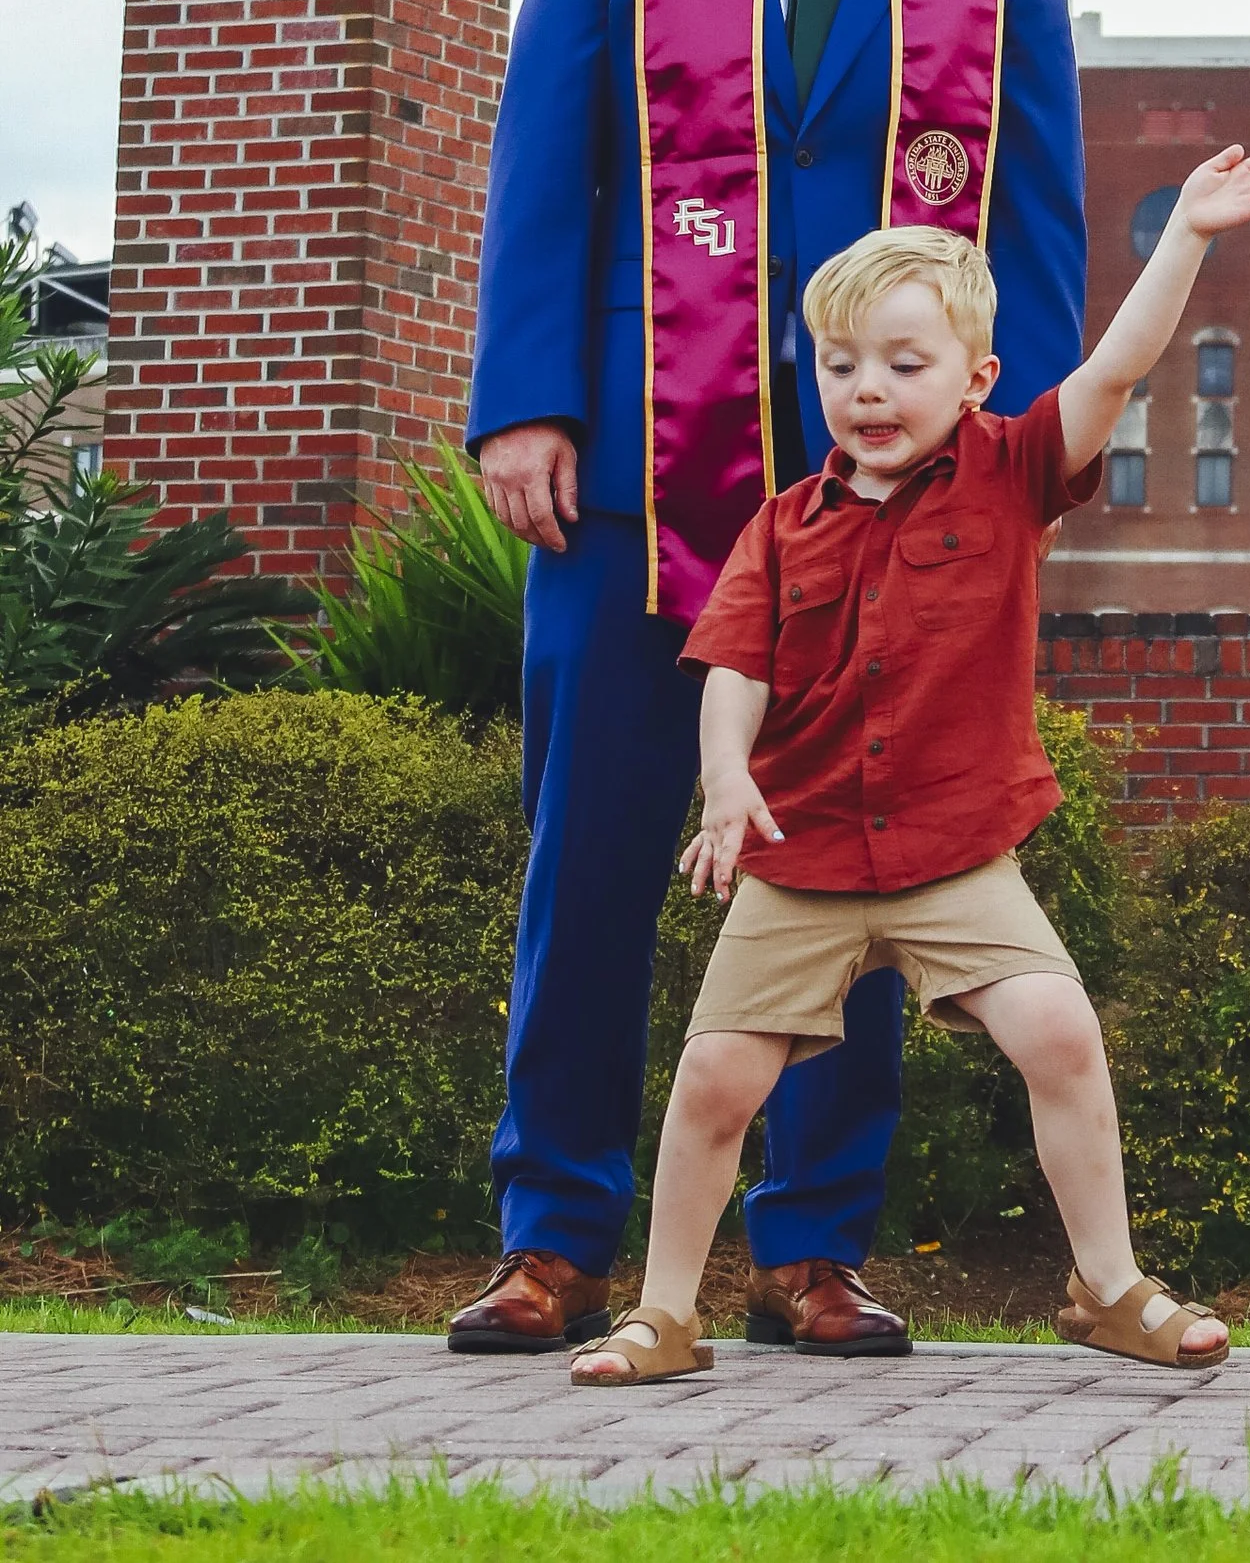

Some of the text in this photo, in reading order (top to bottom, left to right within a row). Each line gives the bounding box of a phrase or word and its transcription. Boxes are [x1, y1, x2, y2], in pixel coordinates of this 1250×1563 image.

[909, 135, 965, 192] FLORIDA STATE UNIVERSITY
[673, 198, 737, 257] FSU
